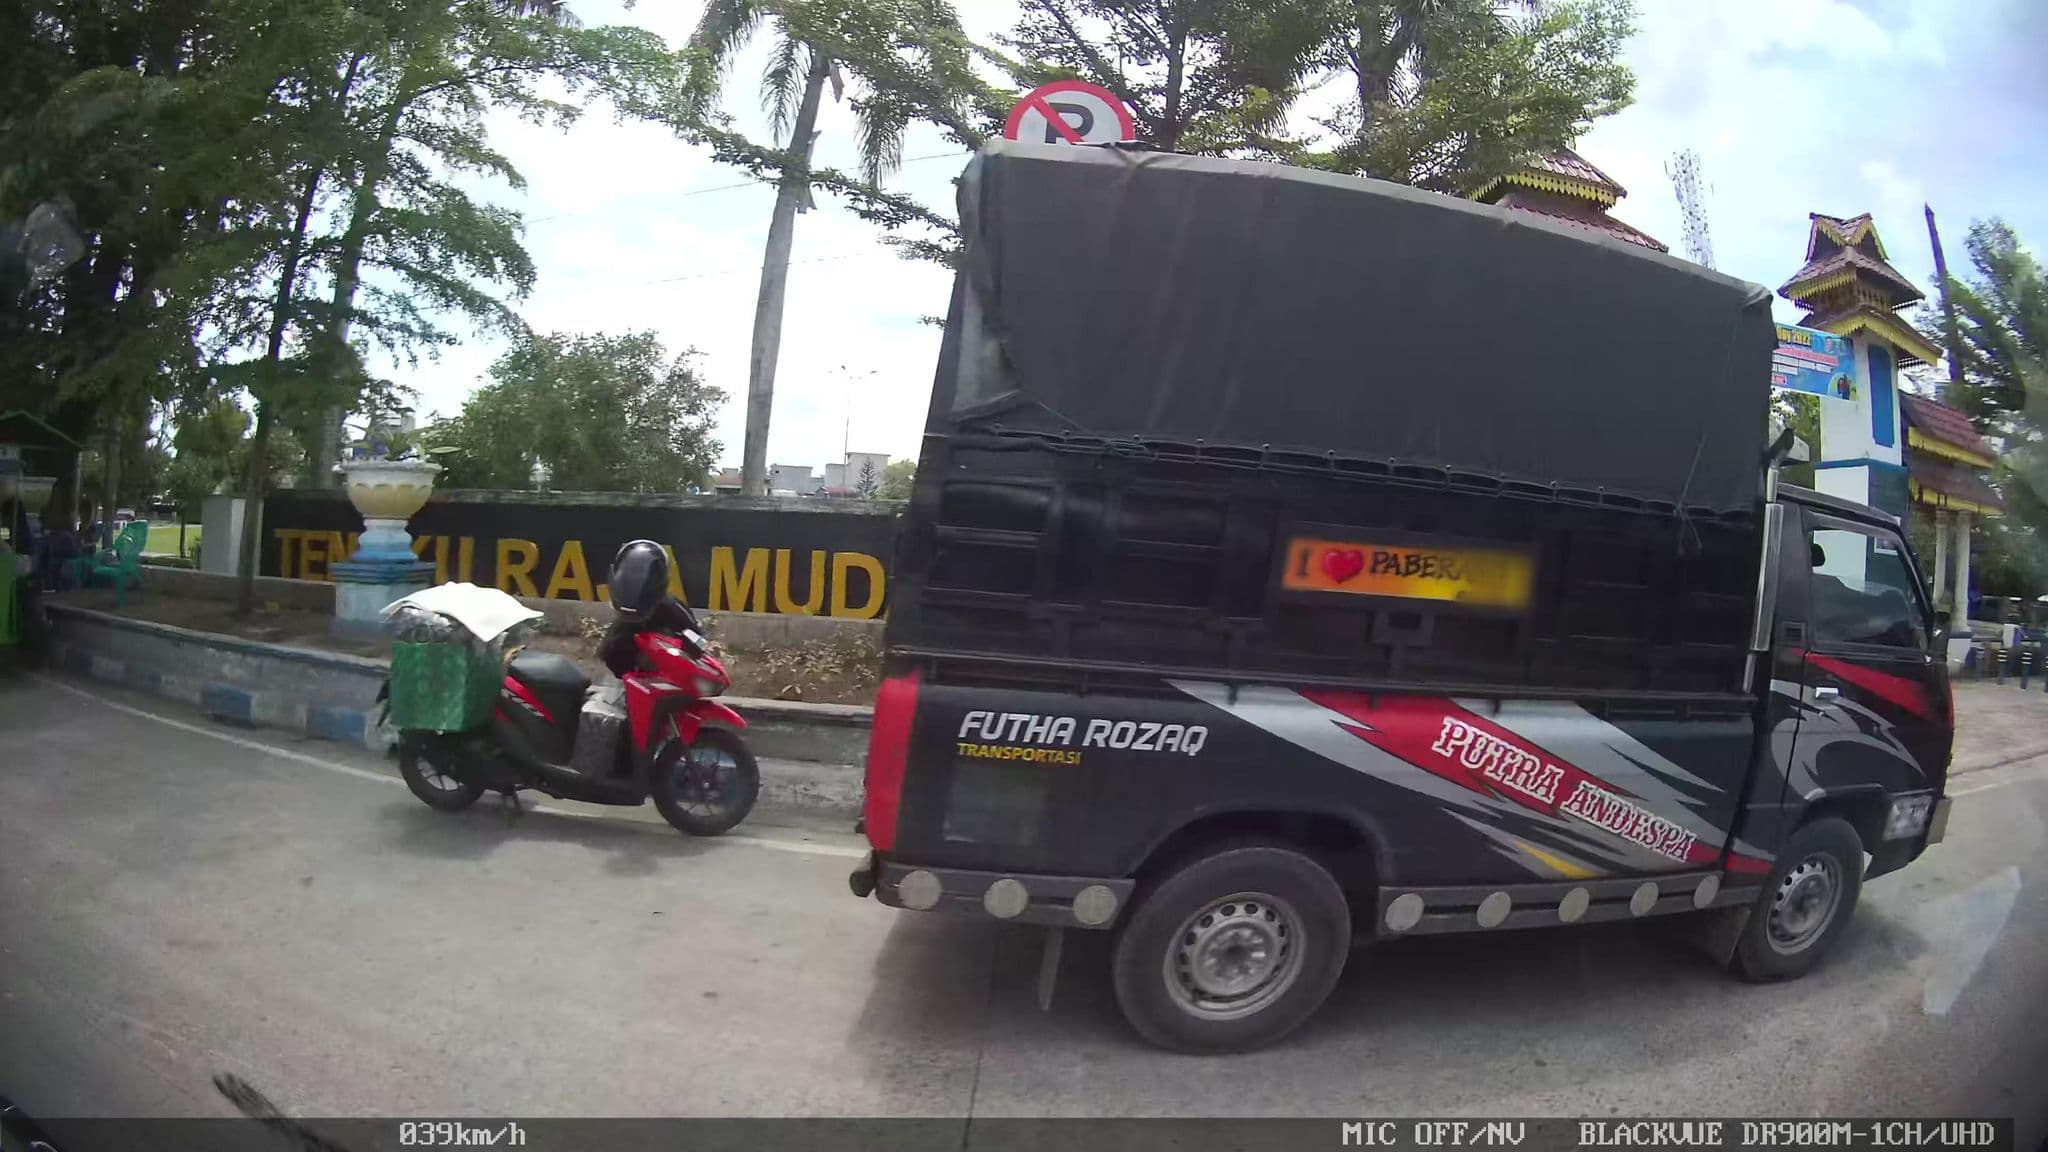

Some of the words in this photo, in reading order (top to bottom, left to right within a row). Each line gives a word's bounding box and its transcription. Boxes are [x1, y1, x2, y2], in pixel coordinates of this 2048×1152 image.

[1045, 102, 1094, 144] P
[707, 546, 889, 620] MUD
[1295, 548, 1312, 578] I
[957, 742, 1082, 766] TRANSPORTASI
[958, 711, 1077, 745] FUTHA
[1082, 719, 1209, 756] ROZAQ
